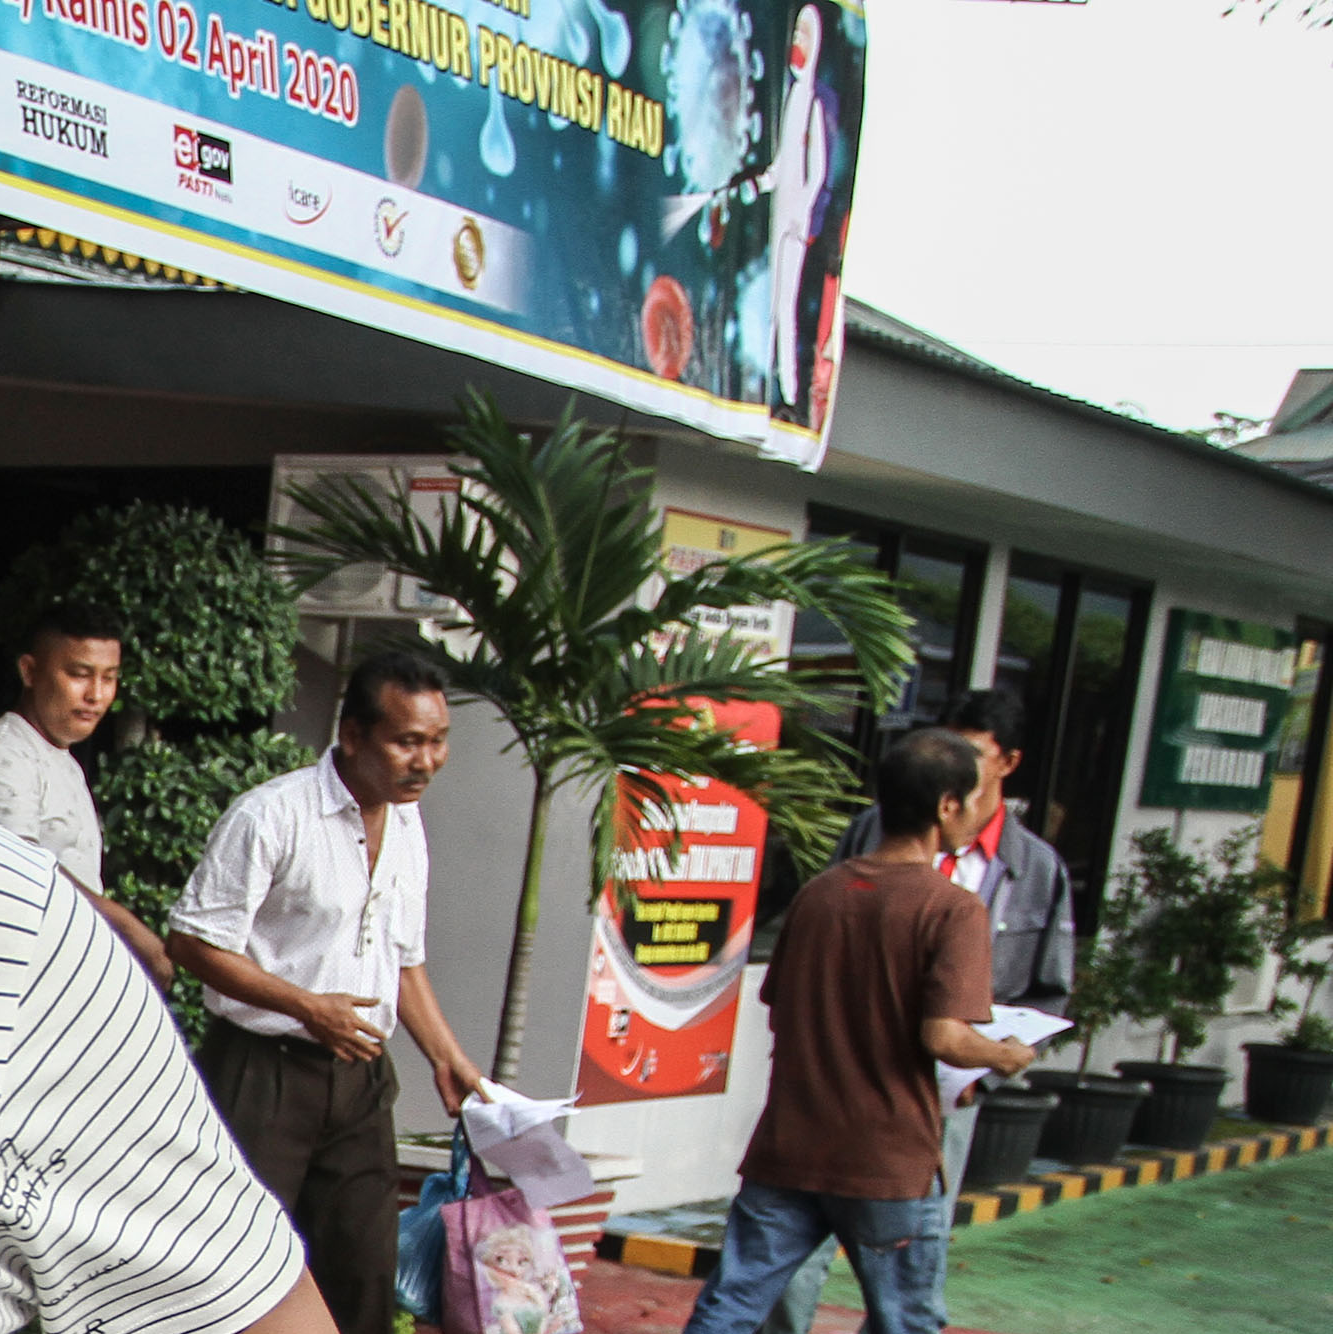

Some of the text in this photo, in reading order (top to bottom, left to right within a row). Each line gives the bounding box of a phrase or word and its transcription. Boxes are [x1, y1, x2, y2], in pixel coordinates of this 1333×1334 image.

[157, 2, 200, 66] 02
[207, 17, 276, 94] April
[286, 48, 356, 123] 2020
[16, 80, 108, 126] REFORMASI
[478, 25, 603, 134] PROVINSI
[607, 81, 664, 158] RIAU
[21, 105, 109, 159] HUKUM
[178, 172, 214, 198] PASTI
